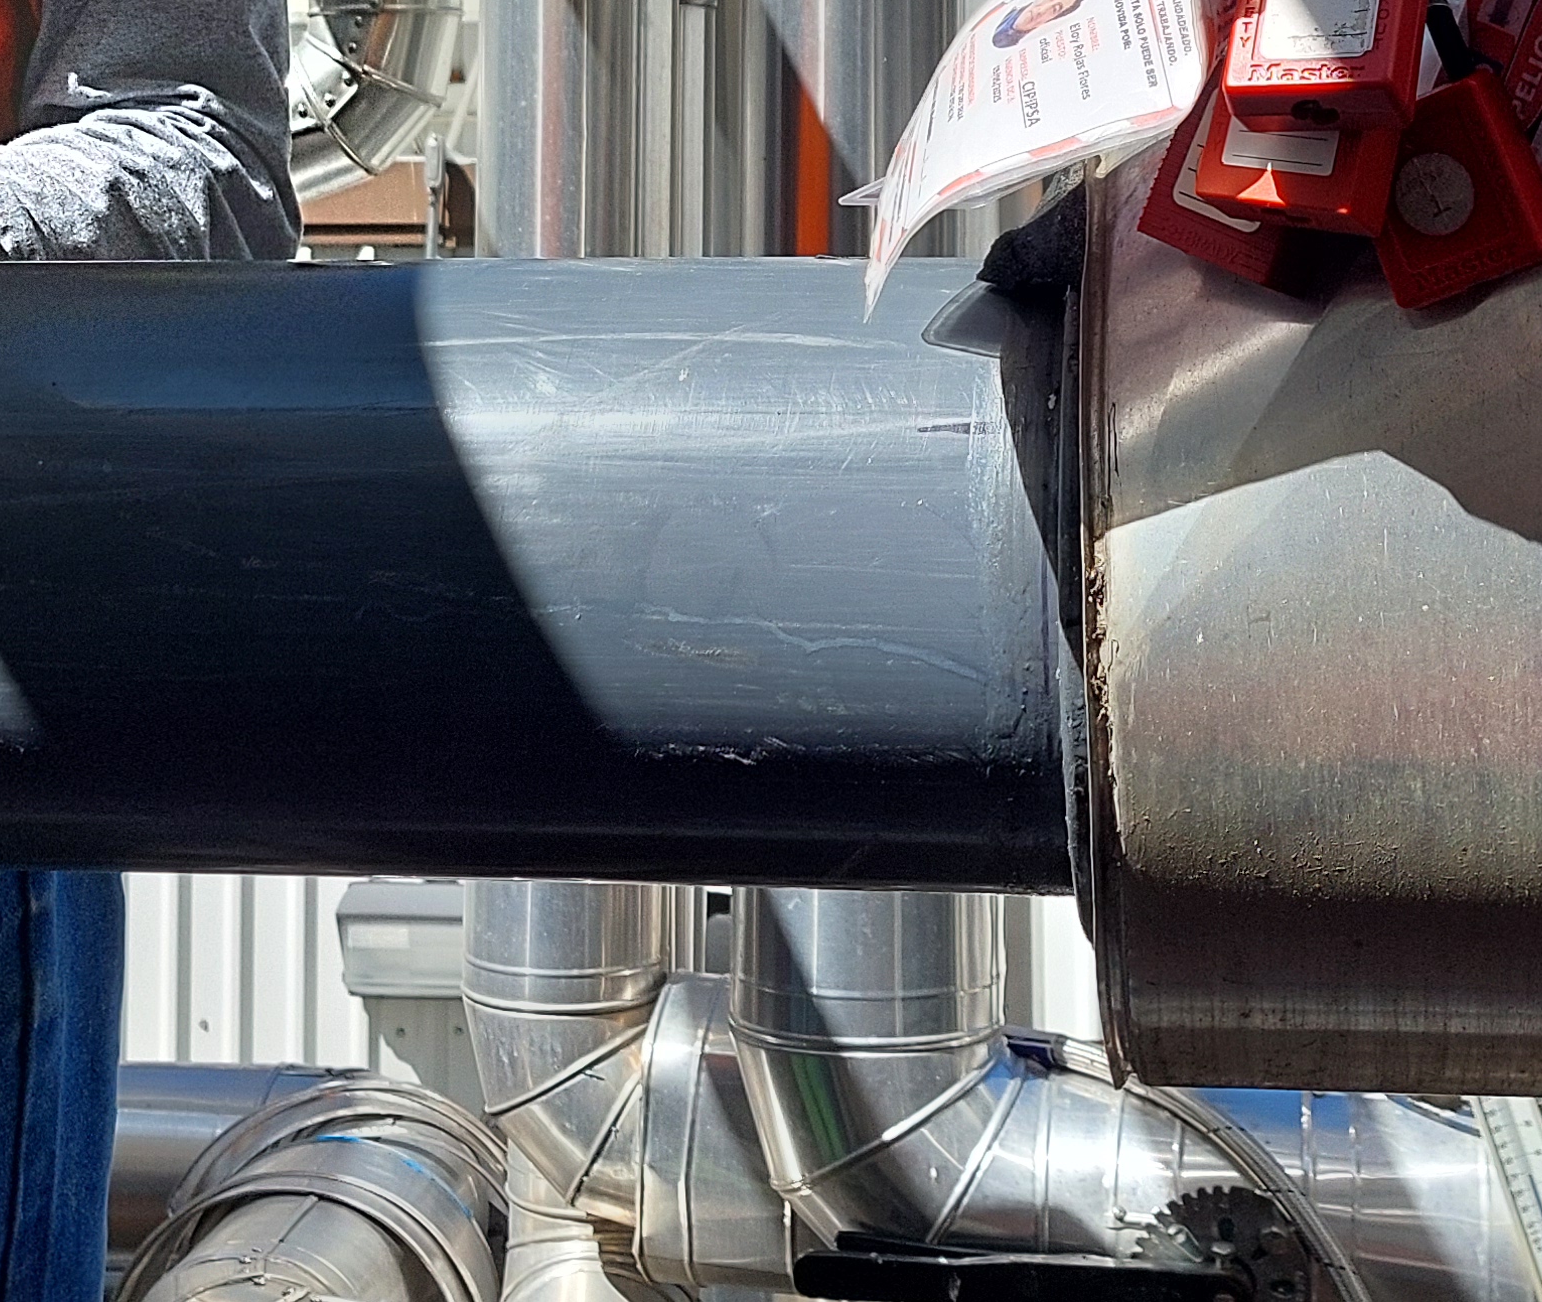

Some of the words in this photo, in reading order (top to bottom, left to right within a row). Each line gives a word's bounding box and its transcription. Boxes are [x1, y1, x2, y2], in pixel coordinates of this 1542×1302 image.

[1068, 22, 1082, 44] Eloy
[1133, 12, 1146, 35] SOLO
[1155, 1, 1178, 66] TRABAJANDO.
[1120, 29, 1132, 50] POR:
[1138, 36, 1153, 66] PUEDE
[1071, 43, 1088, 70] Rojas
[1077, 70, 1092, 100] Flores
[1145, 68, 1158, 87] SER
[1248, 63, 1365, 82] Master
[1021, 80, 1042, 127] CIPIPSA
